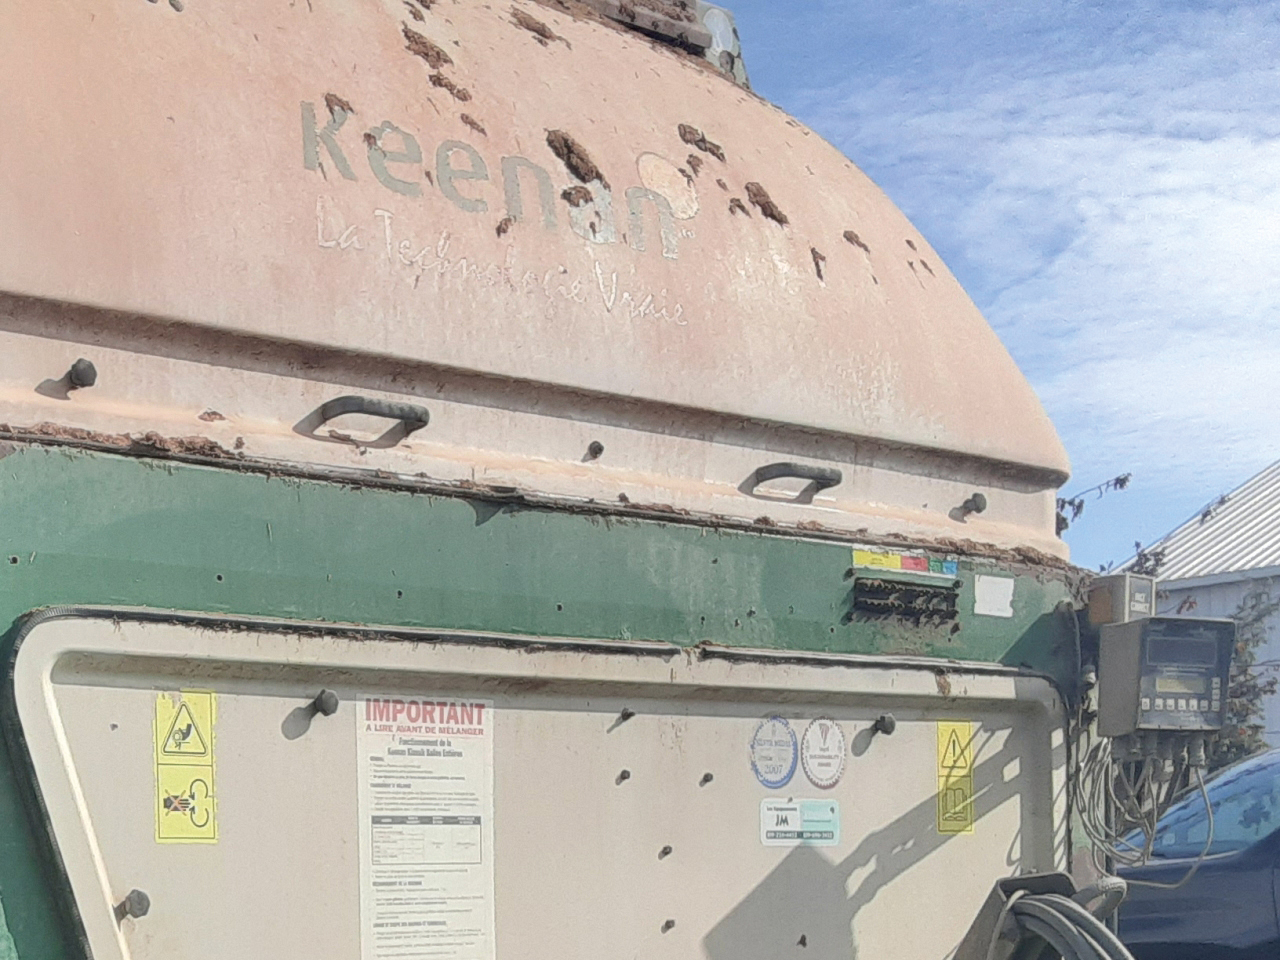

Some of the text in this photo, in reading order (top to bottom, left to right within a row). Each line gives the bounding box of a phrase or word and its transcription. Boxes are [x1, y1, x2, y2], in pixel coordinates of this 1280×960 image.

[365, 698, 485, 725] IMPORTANT
[374, 723, 393, 733] LIRE
[395, 725, 423, 734] AVANT
[424, 726, 437, 734] DE
[764, 764, 783, 775] 2007
[775, 814, 789, 827] JM
